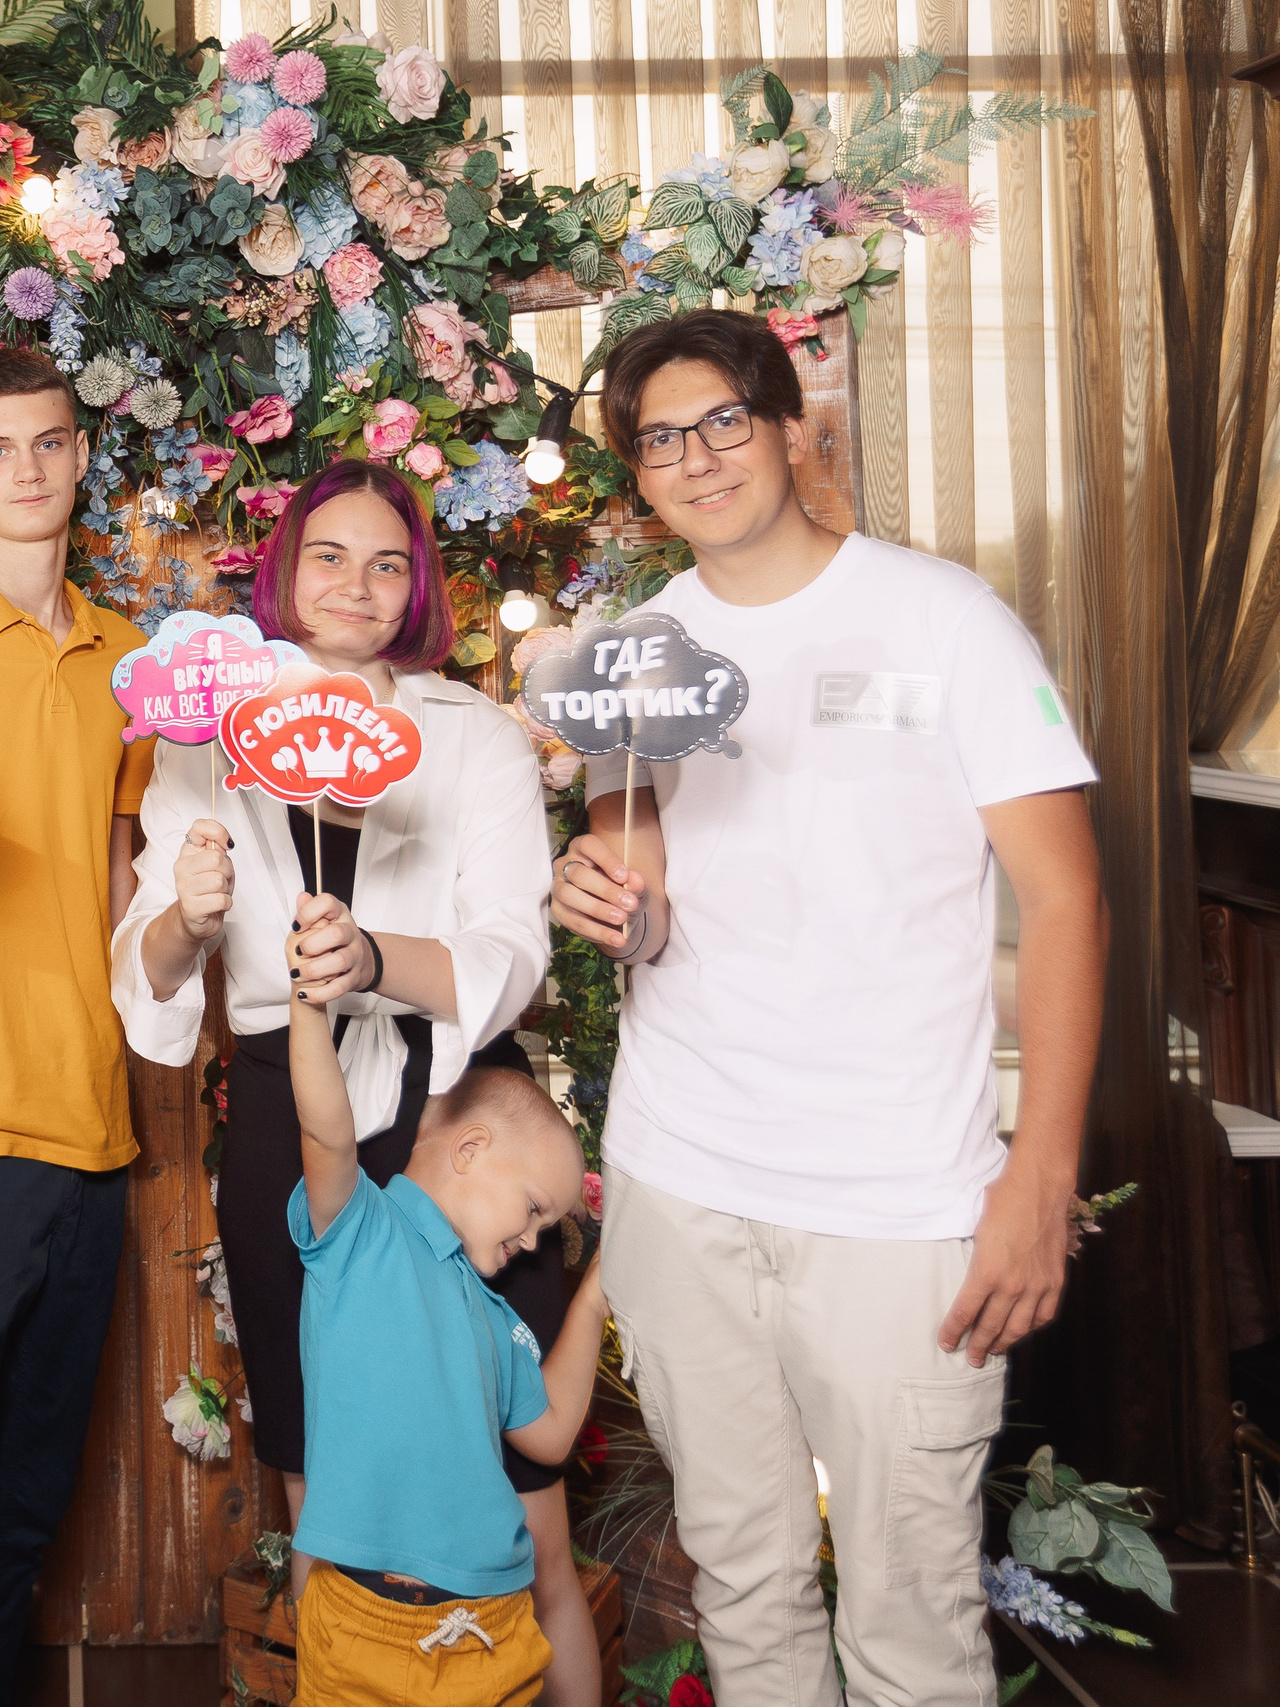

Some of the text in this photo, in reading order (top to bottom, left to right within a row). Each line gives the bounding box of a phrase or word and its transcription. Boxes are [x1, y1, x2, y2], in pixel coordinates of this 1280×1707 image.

[207, 633, 222, 660] Я
[594, 635, 668, 682] ГДЕ
[173, 656, 275, 691] ВКУСНЫЙ
[144, 695, 175, 720] КАК
[179, 692, 208, 717] ВСЕ
[819, 711, 868, 723] EMPORIO
[239, 729, 258, 749] С
[253, 693, 407, 761] ЮБИЛЕЕМ!
